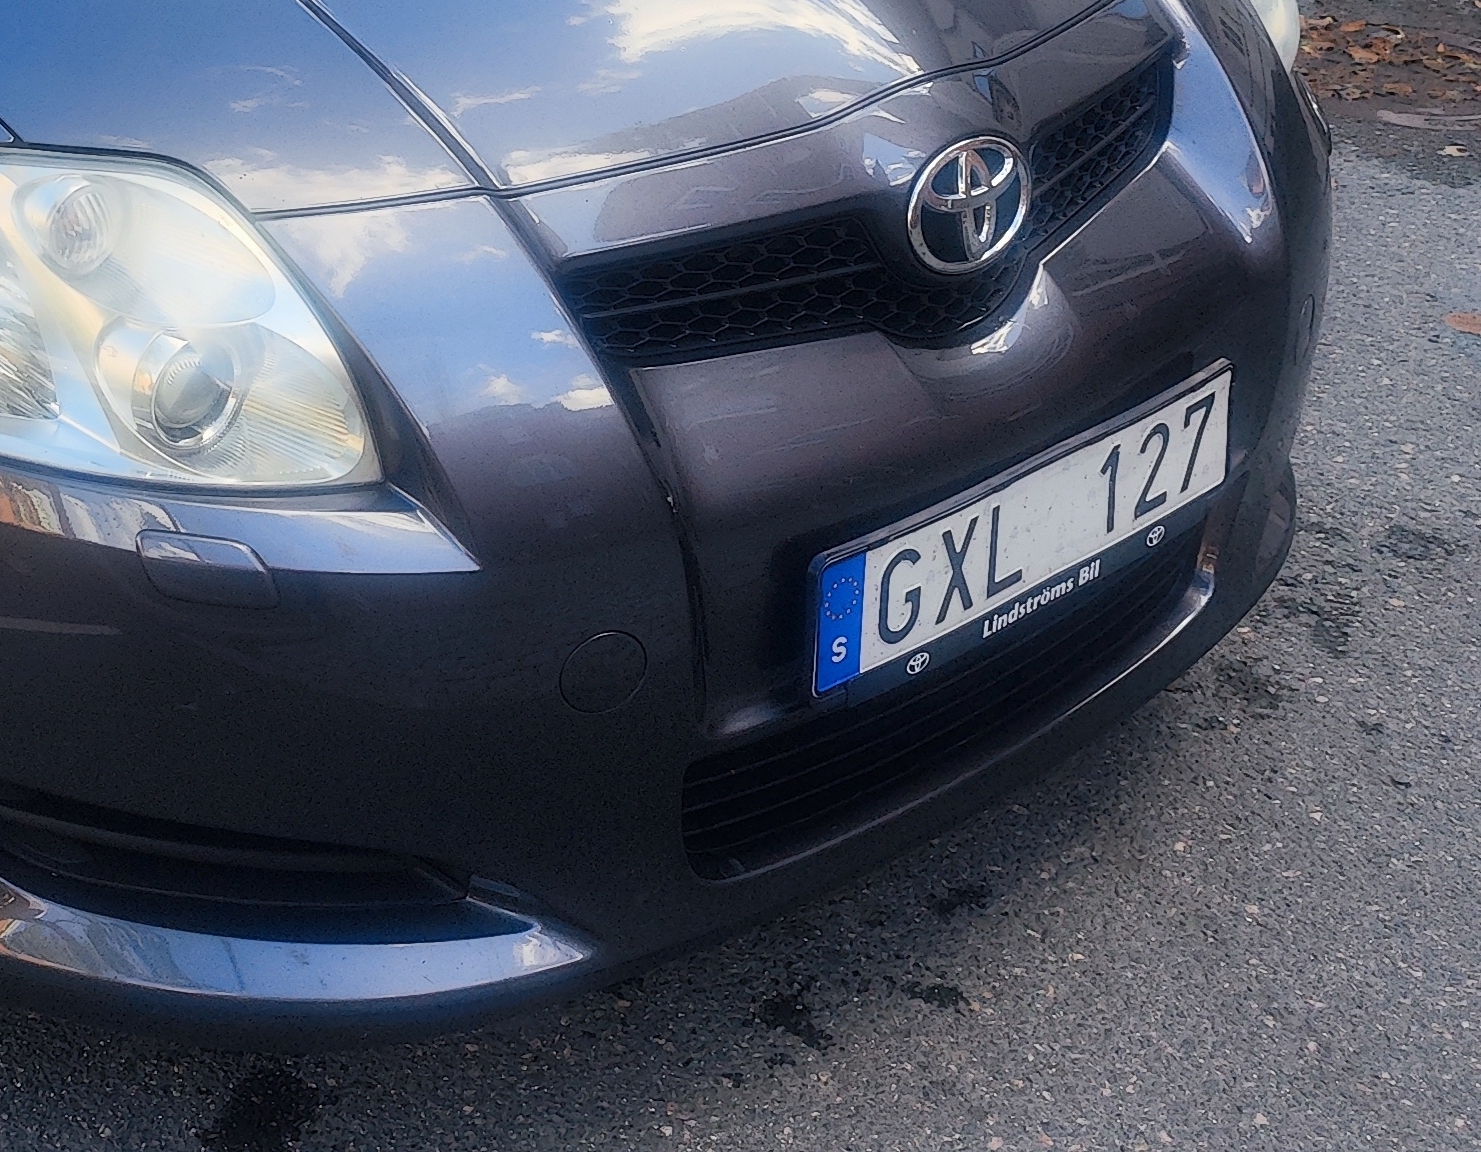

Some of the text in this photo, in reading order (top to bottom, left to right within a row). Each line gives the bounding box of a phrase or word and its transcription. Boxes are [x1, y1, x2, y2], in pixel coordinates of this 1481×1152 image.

[879, 391, 1216, 644] GXL 127
[982, 558, 1101, 639] Lindströms Bil
[831, 636, 848, 663] S
